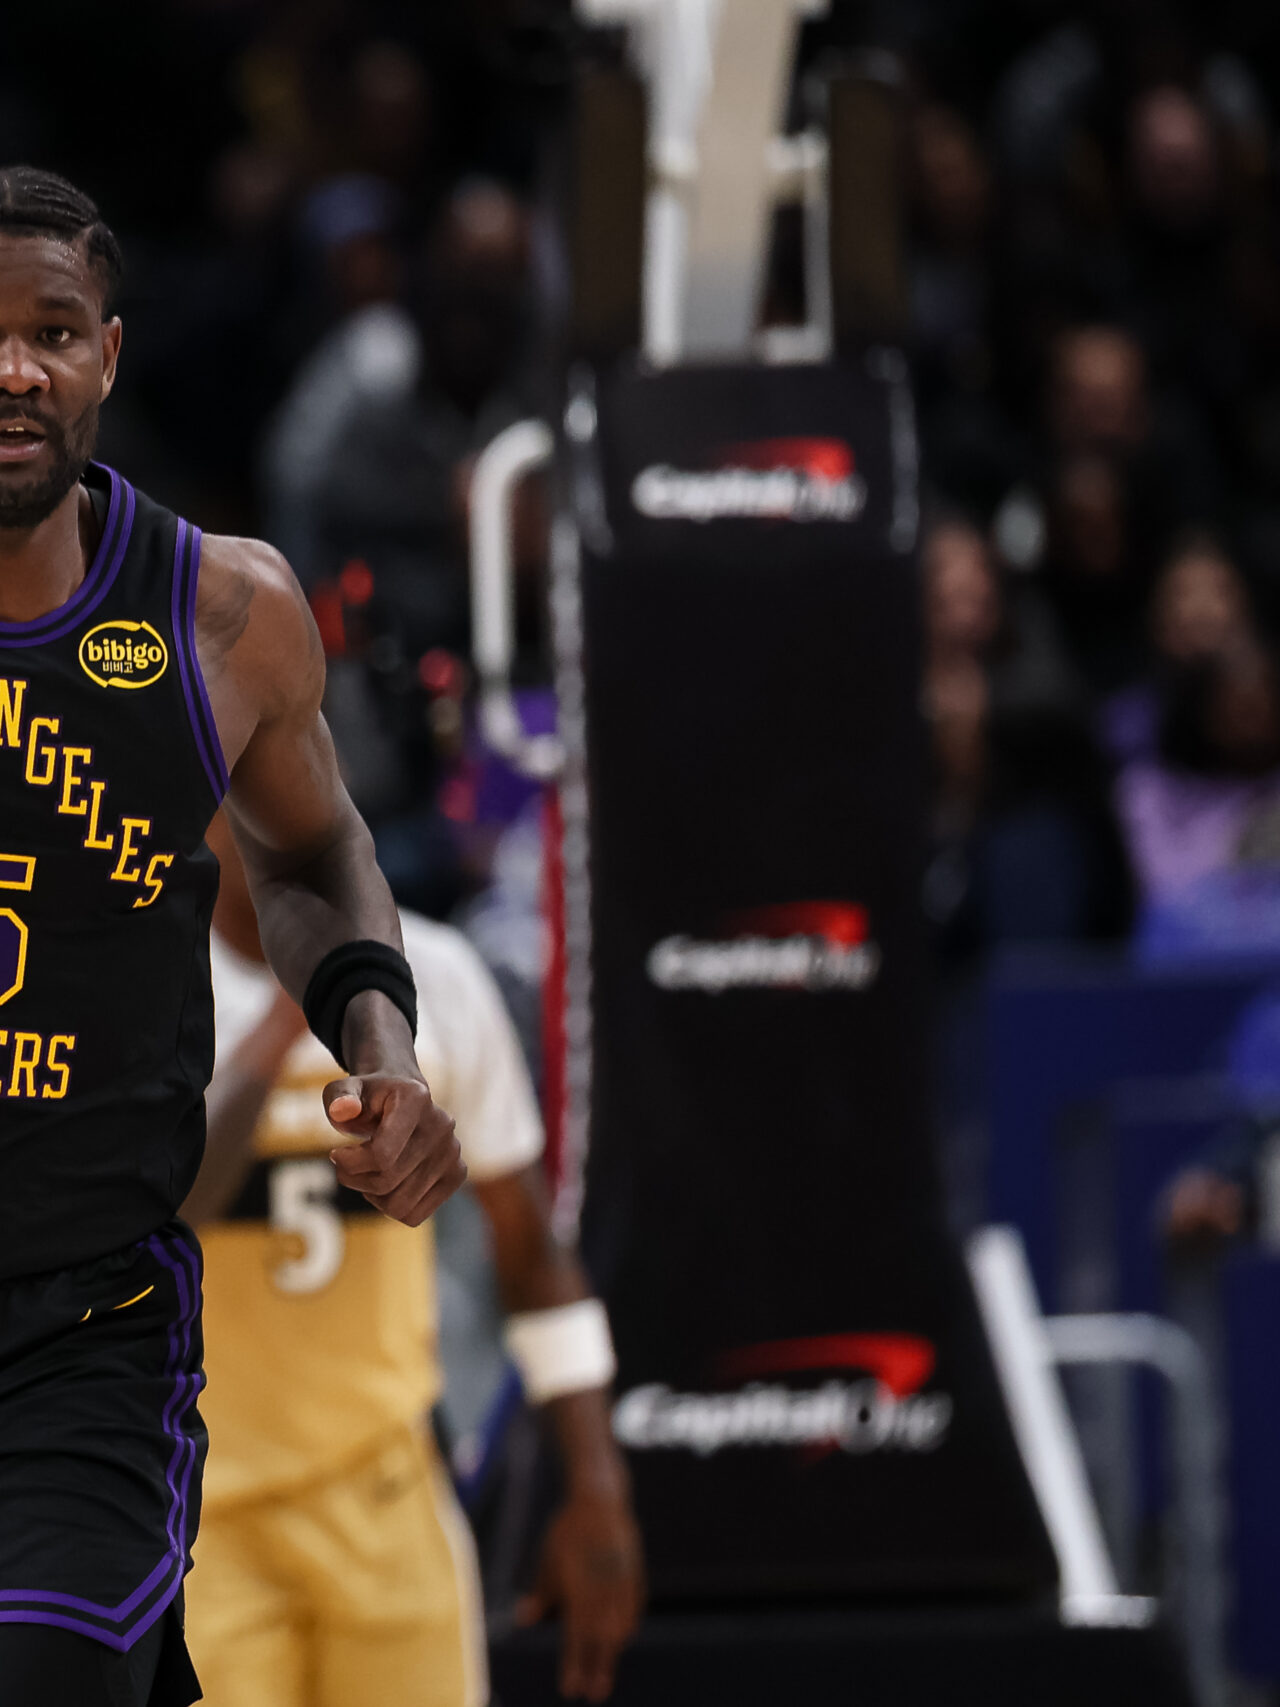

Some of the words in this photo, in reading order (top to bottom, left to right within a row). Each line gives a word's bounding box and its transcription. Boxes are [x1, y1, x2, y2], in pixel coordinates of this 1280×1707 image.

[87, 638, 162, 669] bibigo
[102, 661, 134, 674] 비비고
[271, 1158, 346, 1294] 5
